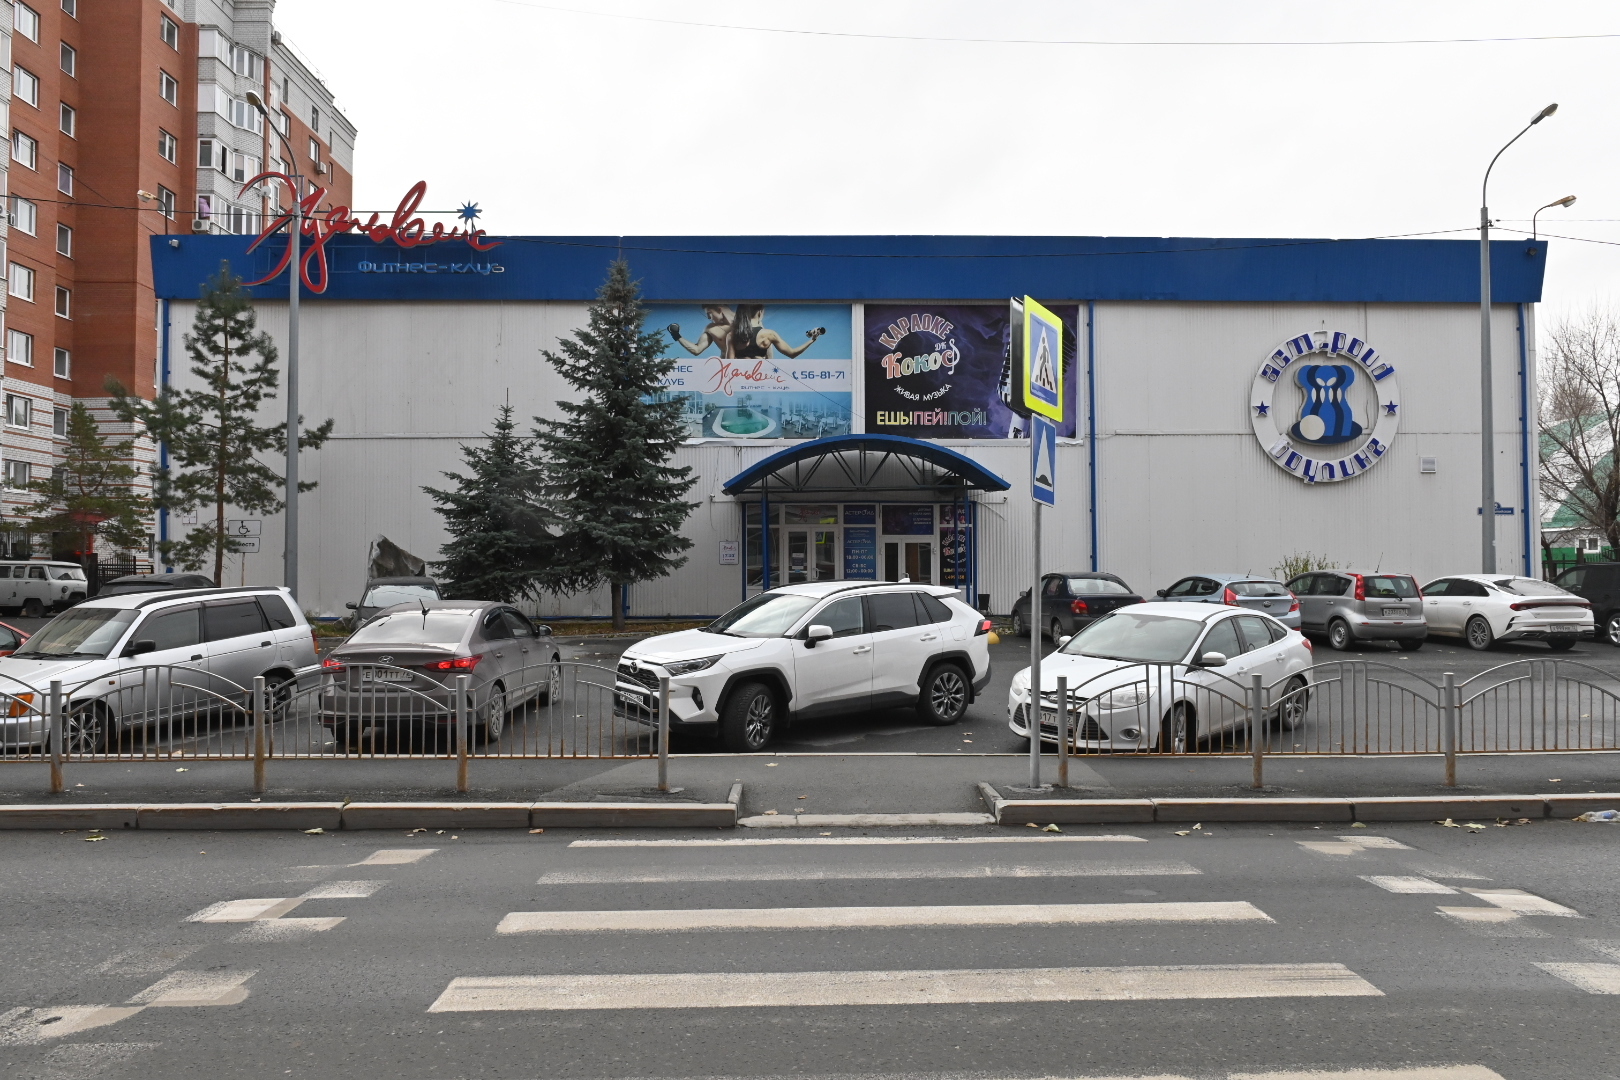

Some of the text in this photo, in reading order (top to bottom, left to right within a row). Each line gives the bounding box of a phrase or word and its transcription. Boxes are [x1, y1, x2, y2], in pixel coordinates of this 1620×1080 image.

[879, 313, 954, 350] КАРАОКЕ
[657, 378, 685, 386] КЛУБ
[801, 370, 845, 380] 56-81-71
[894, 383, 952, 401] ЖИВАЯ МУЗЫКА
